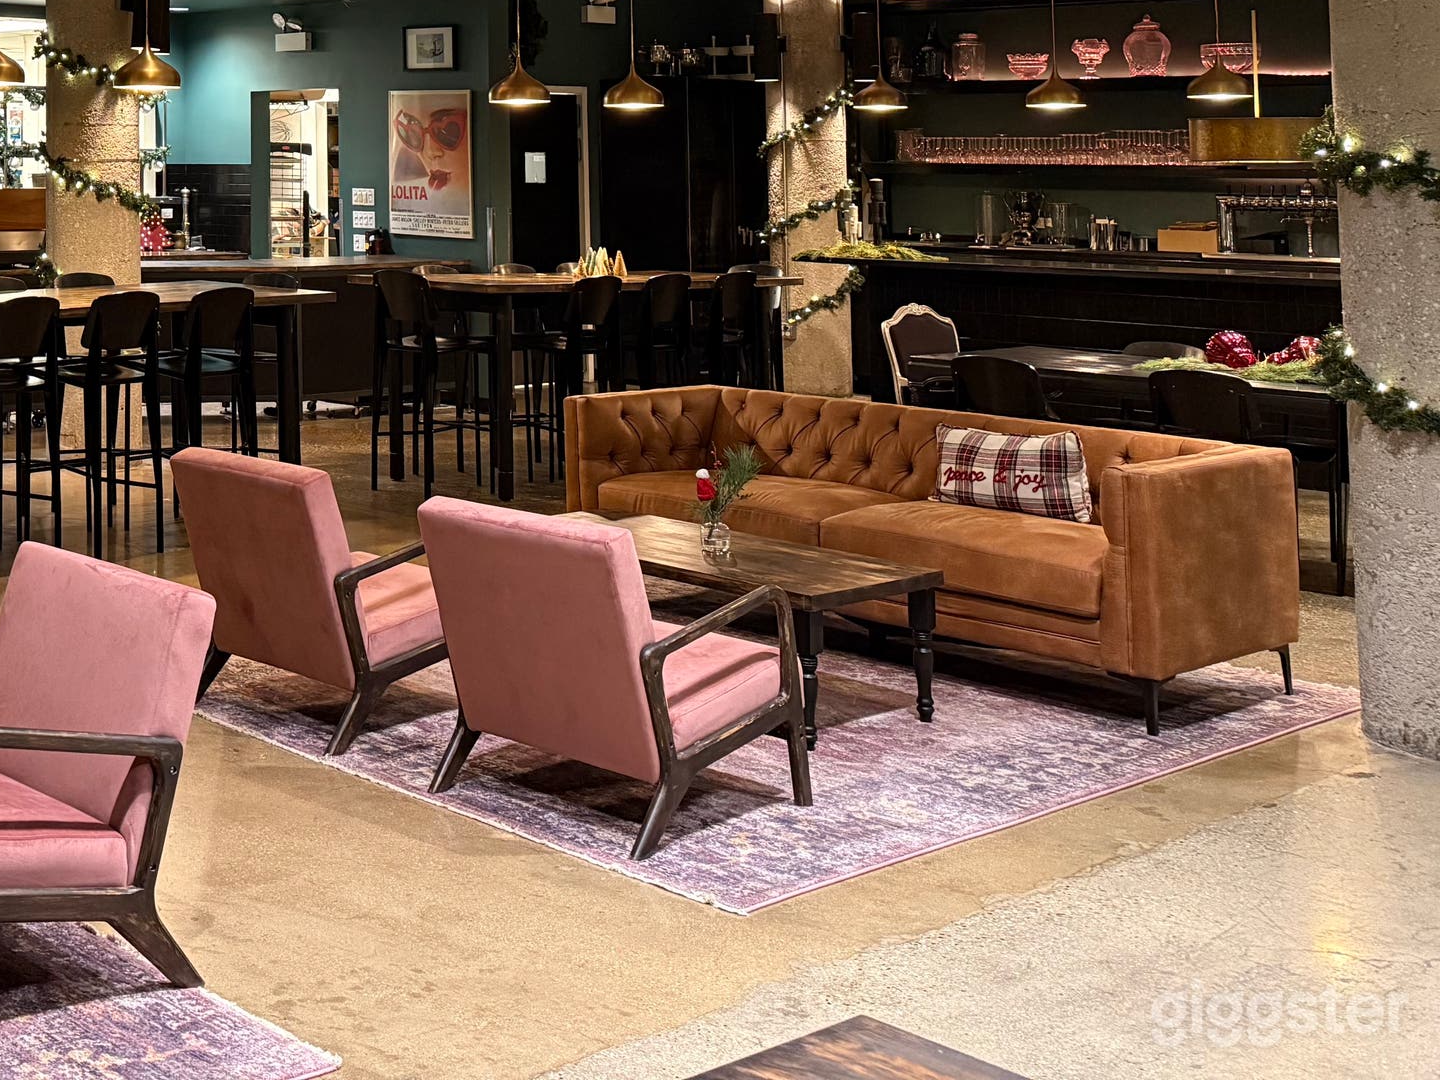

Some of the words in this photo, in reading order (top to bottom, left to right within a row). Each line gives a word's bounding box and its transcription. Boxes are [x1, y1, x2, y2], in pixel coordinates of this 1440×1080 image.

[391, 185, 428, 200] LOLITA
[943, 466, 986, 486] peace
[993, 466, 1007, 484] &
[1012, 468, 1047, 493] joy
